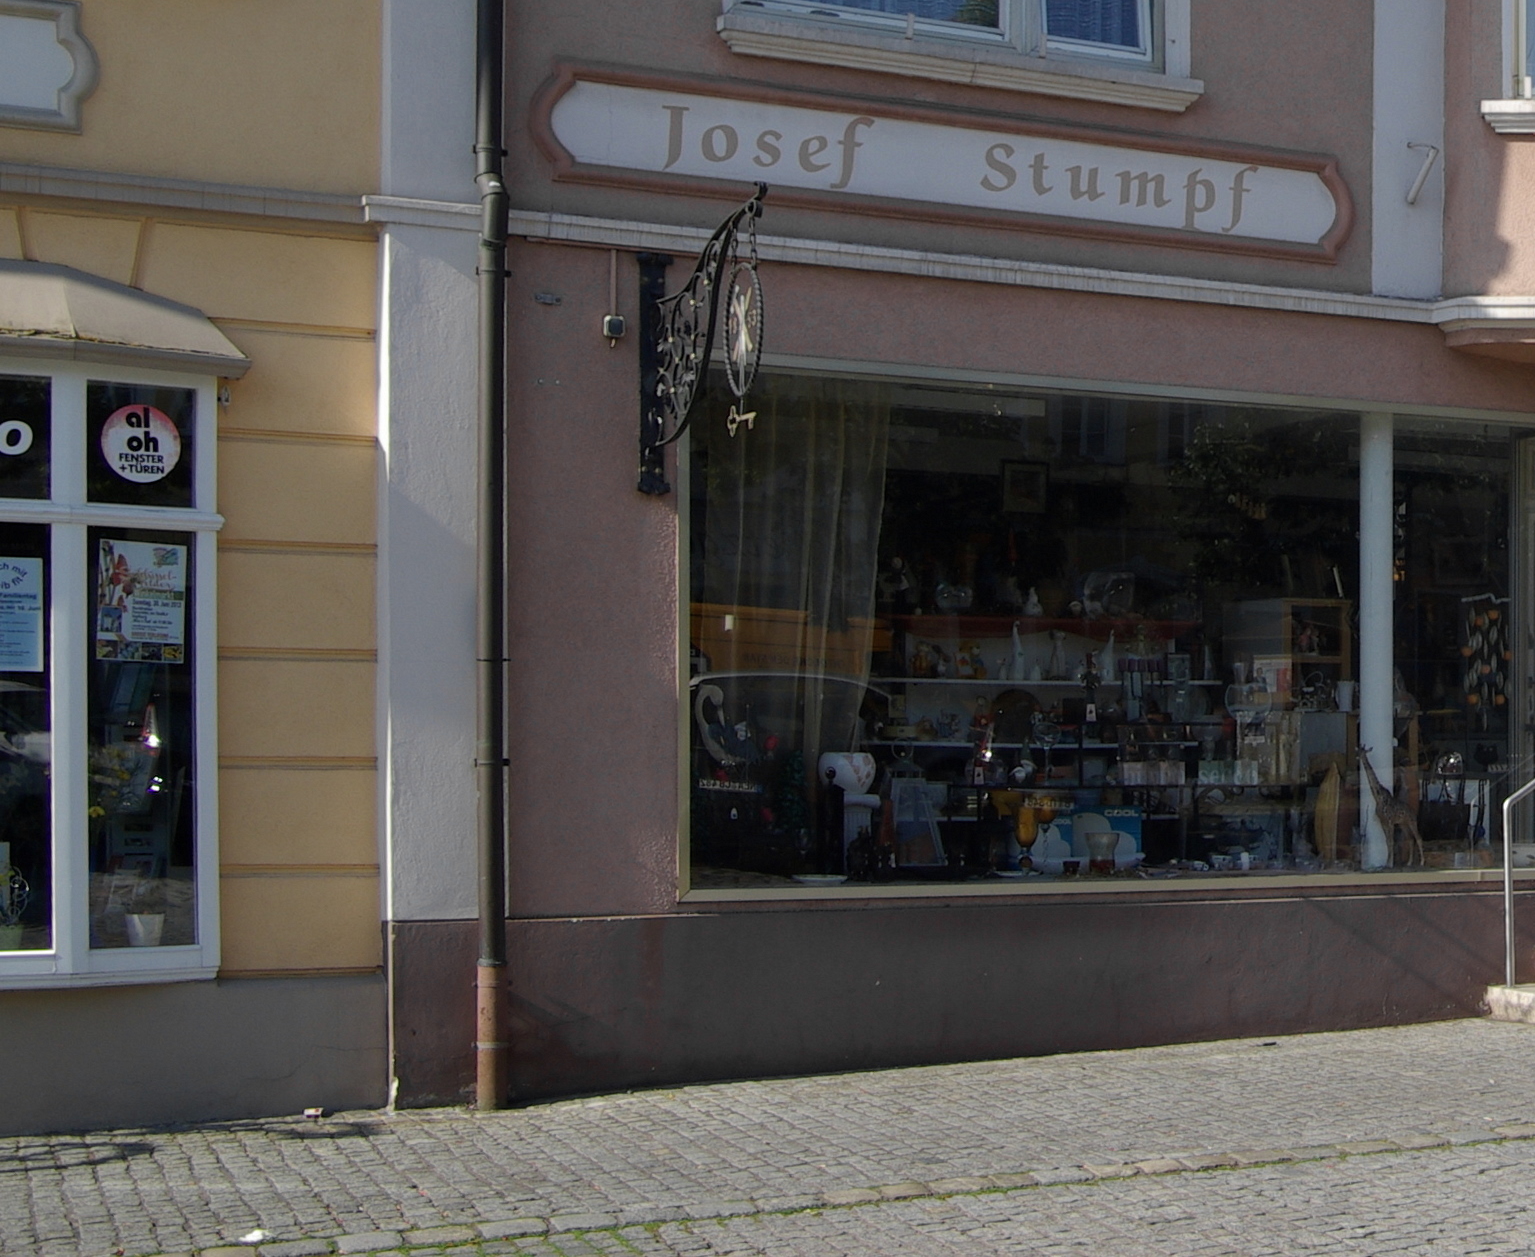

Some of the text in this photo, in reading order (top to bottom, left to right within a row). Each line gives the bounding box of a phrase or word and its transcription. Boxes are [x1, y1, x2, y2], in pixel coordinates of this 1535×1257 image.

[659, 104, 1259, 234] Josef Stumpf
[125, 406, 150, 429] al
[126, 430, 159, 453] oh
[118, 452, 164, 464] FENSTER
[1103, 809, 1139, 817] COOL
